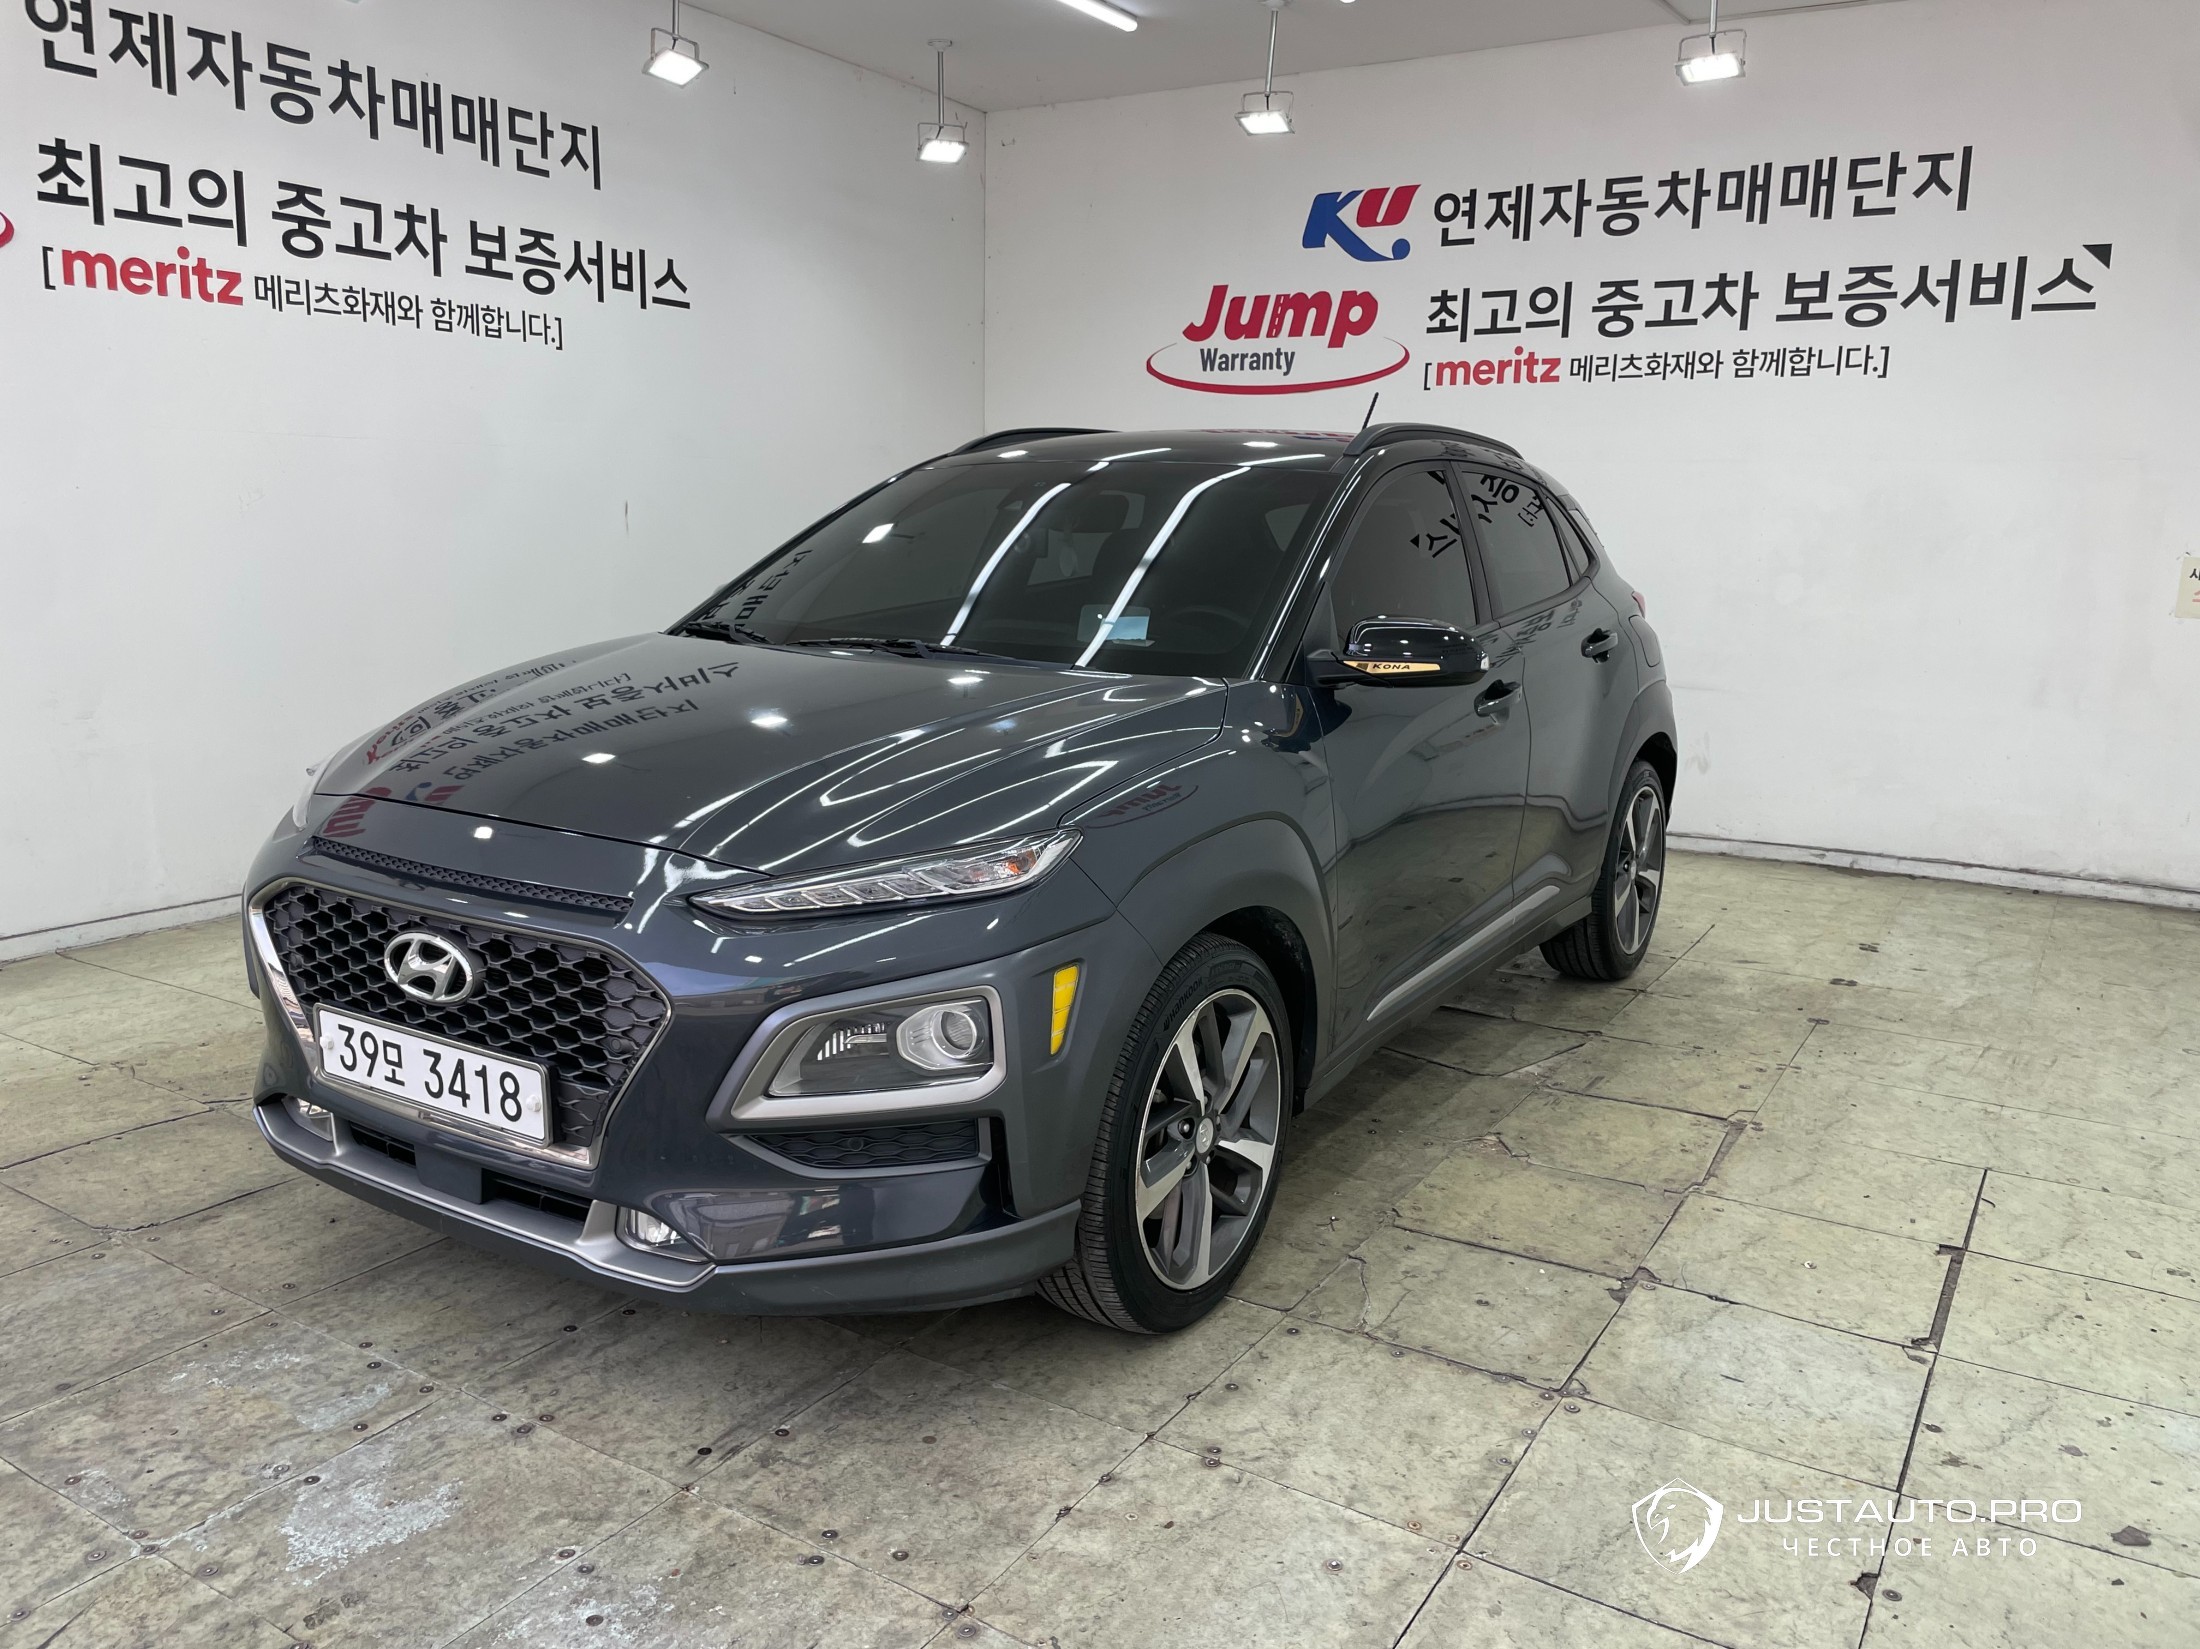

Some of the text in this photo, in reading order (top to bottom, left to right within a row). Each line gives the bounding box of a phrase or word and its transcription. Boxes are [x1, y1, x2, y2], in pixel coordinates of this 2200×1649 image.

[25, 0, 601, 190] 연제자동차매매단지
[37, 137, 691, 310] 최고의 중고차 보증서비스
[1433, 145, 1973, 247] 연제자동차매매단지
[254, 274, 424, 330] 메리츠화재와
[430, 297, 563, 351] 함께합니다.]
[1182, 284, 1379, 349] Jump
[1426, 255, 2097, 343] 최고의 중고차 보증서비스
[1199, 346, 1296, 377] Warranty
[1569, 349, 1725, 383] 메리츠화재와
[1732, 344, 1890, 379] 함께합니다.]
[1372, 663, 1411, 671] KONA
[337, 1023, 523, 1123] 39모 3418
